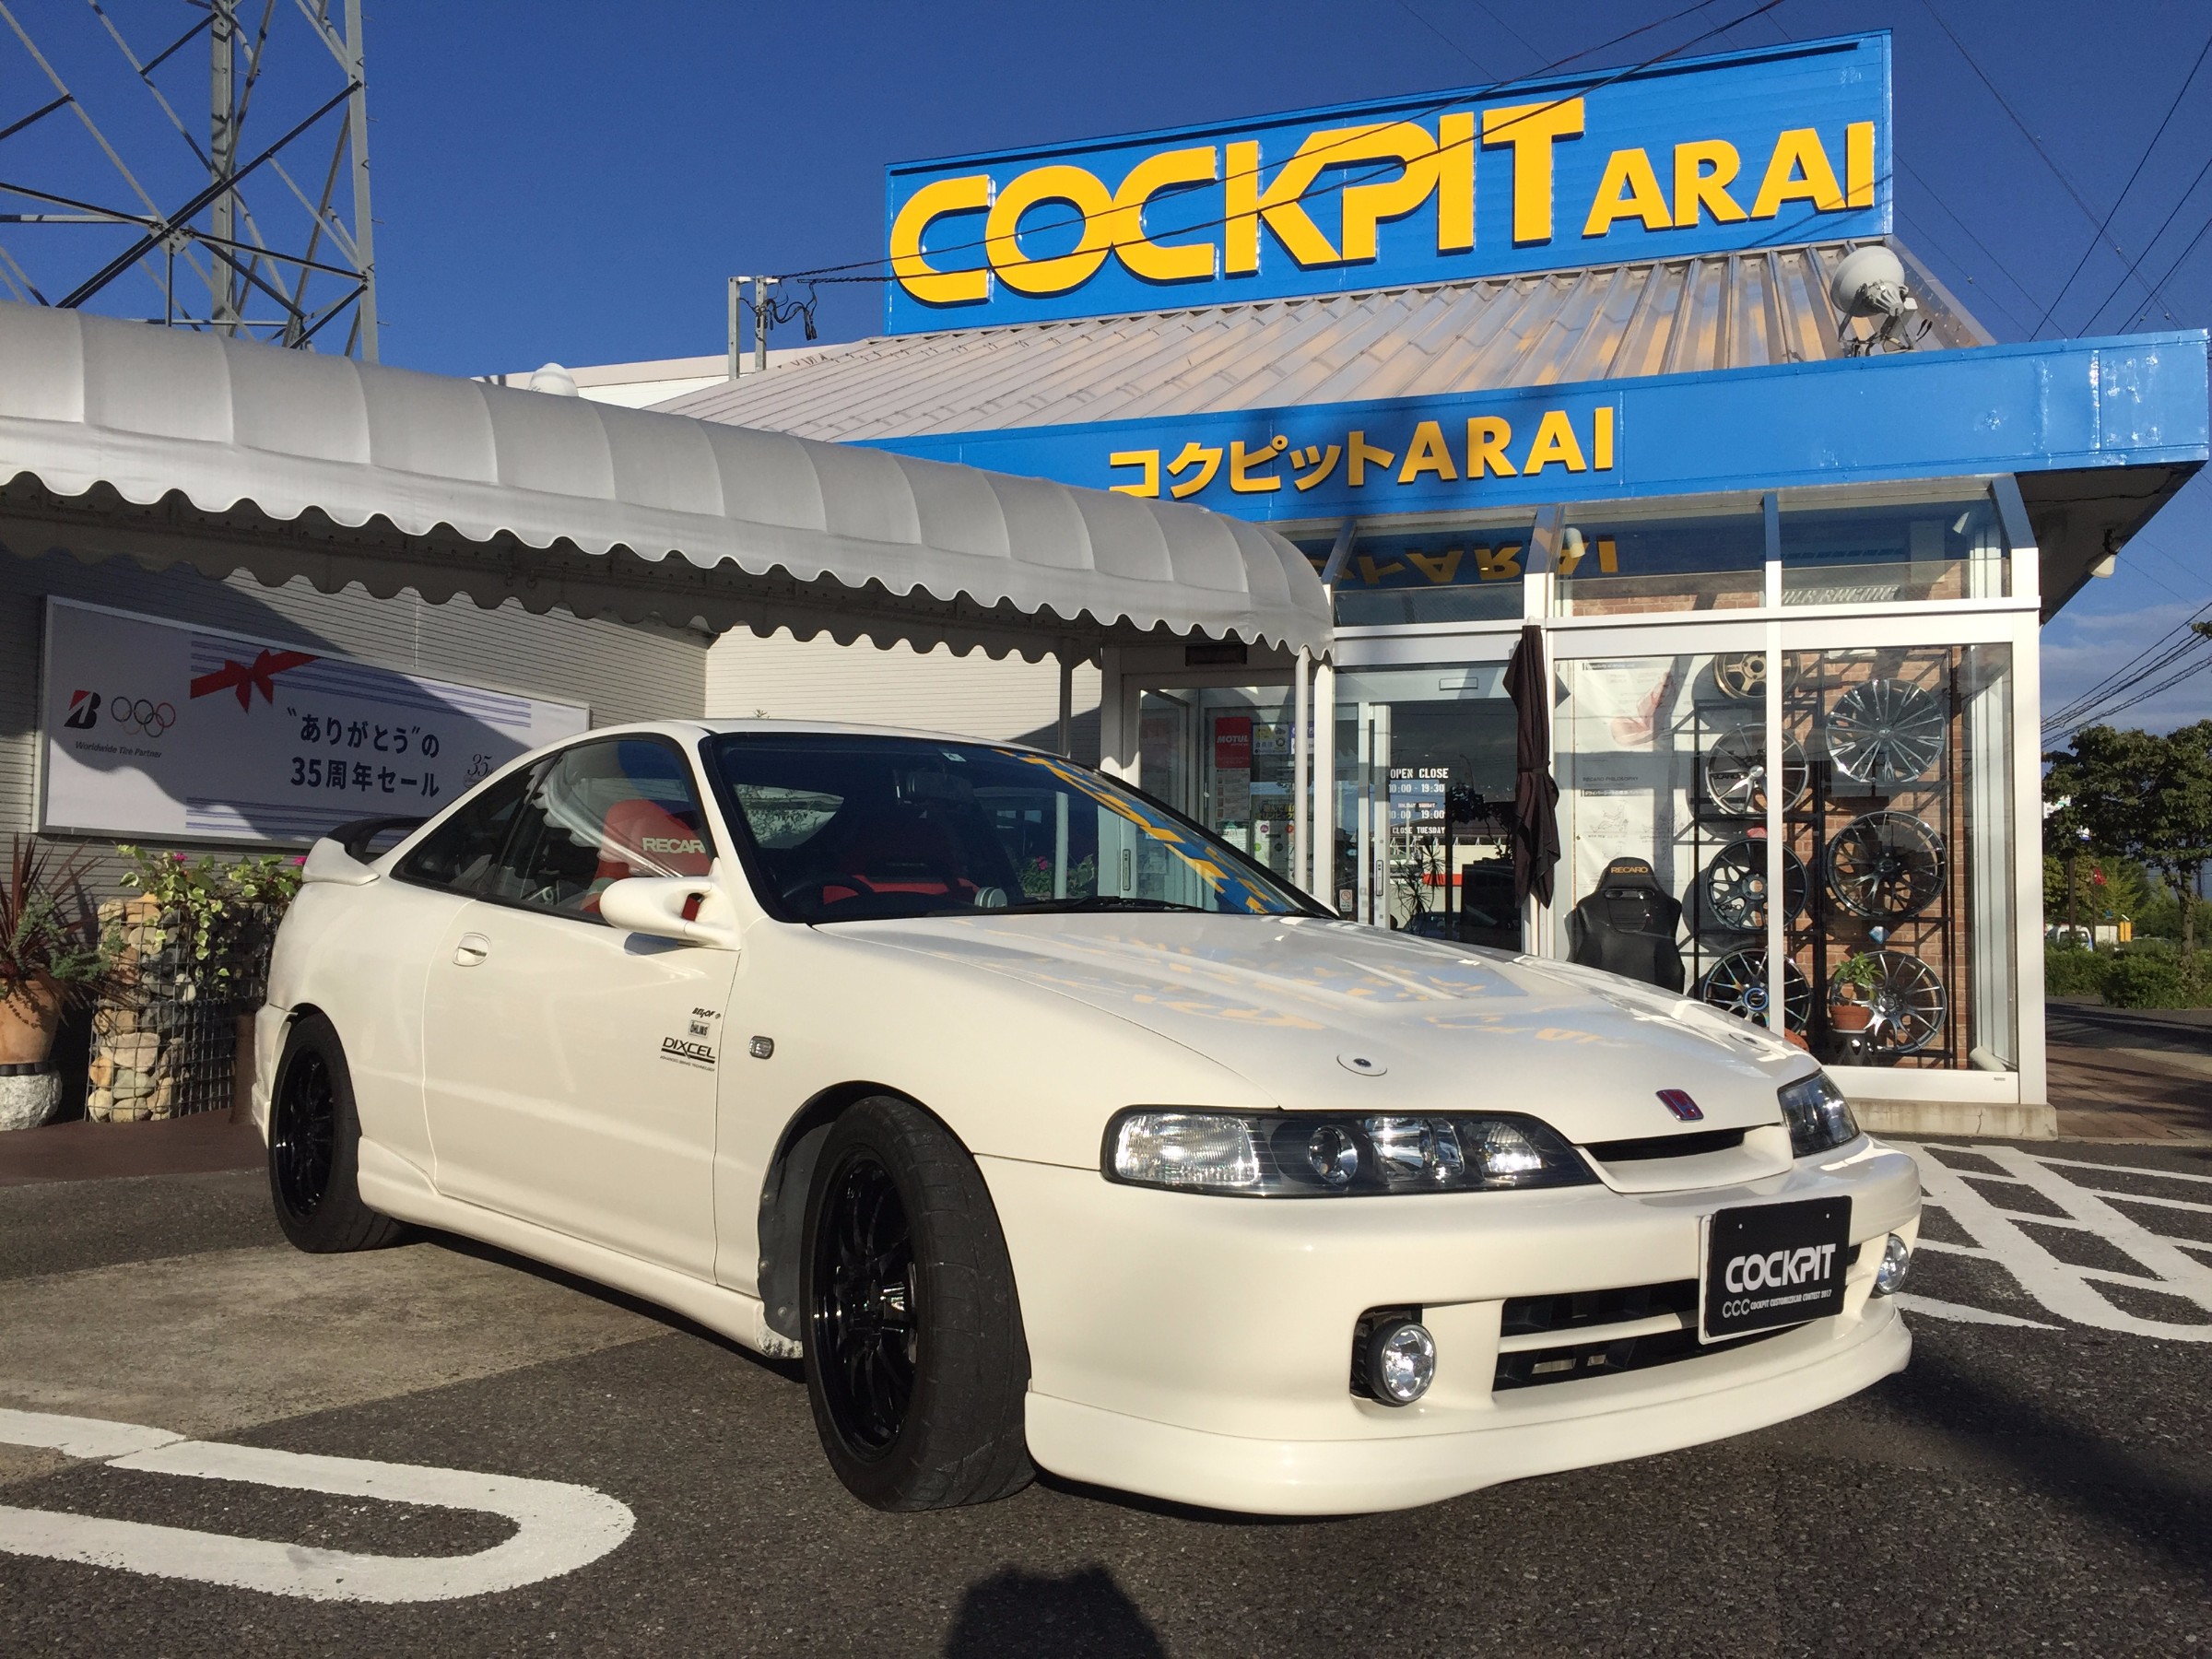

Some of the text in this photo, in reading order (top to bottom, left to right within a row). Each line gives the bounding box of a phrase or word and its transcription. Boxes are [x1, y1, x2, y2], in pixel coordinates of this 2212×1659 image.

[889, 97, 1876, 305] COCKPIT ARAI
[76, 741, 162, 758] Worldwide Tire Partner
[290, 756, 440, 798] 35周年セール
[1390, 768, 1449, 779] OPEN CLOSE
[1388, 783, 1412, 794] 10:00
[1420, 782, 1445, 793] 19:30
[1391, 810, 1446, 819] 0:00 19:00
[1392, 826, 1446, 834] CLOSE TUESDAY
[642, 837, 707, 853] RECAR
[662, 1036, 716, 1059] DIXCEL
[1724, 1242, 1836, 1293] COCKPIT
[1722, 1298, 1750, 1319] CCC
[1750, 1299, 1770, 1310] COCKPIT
[1803, 1290, 1821, 1301] CONTEST
